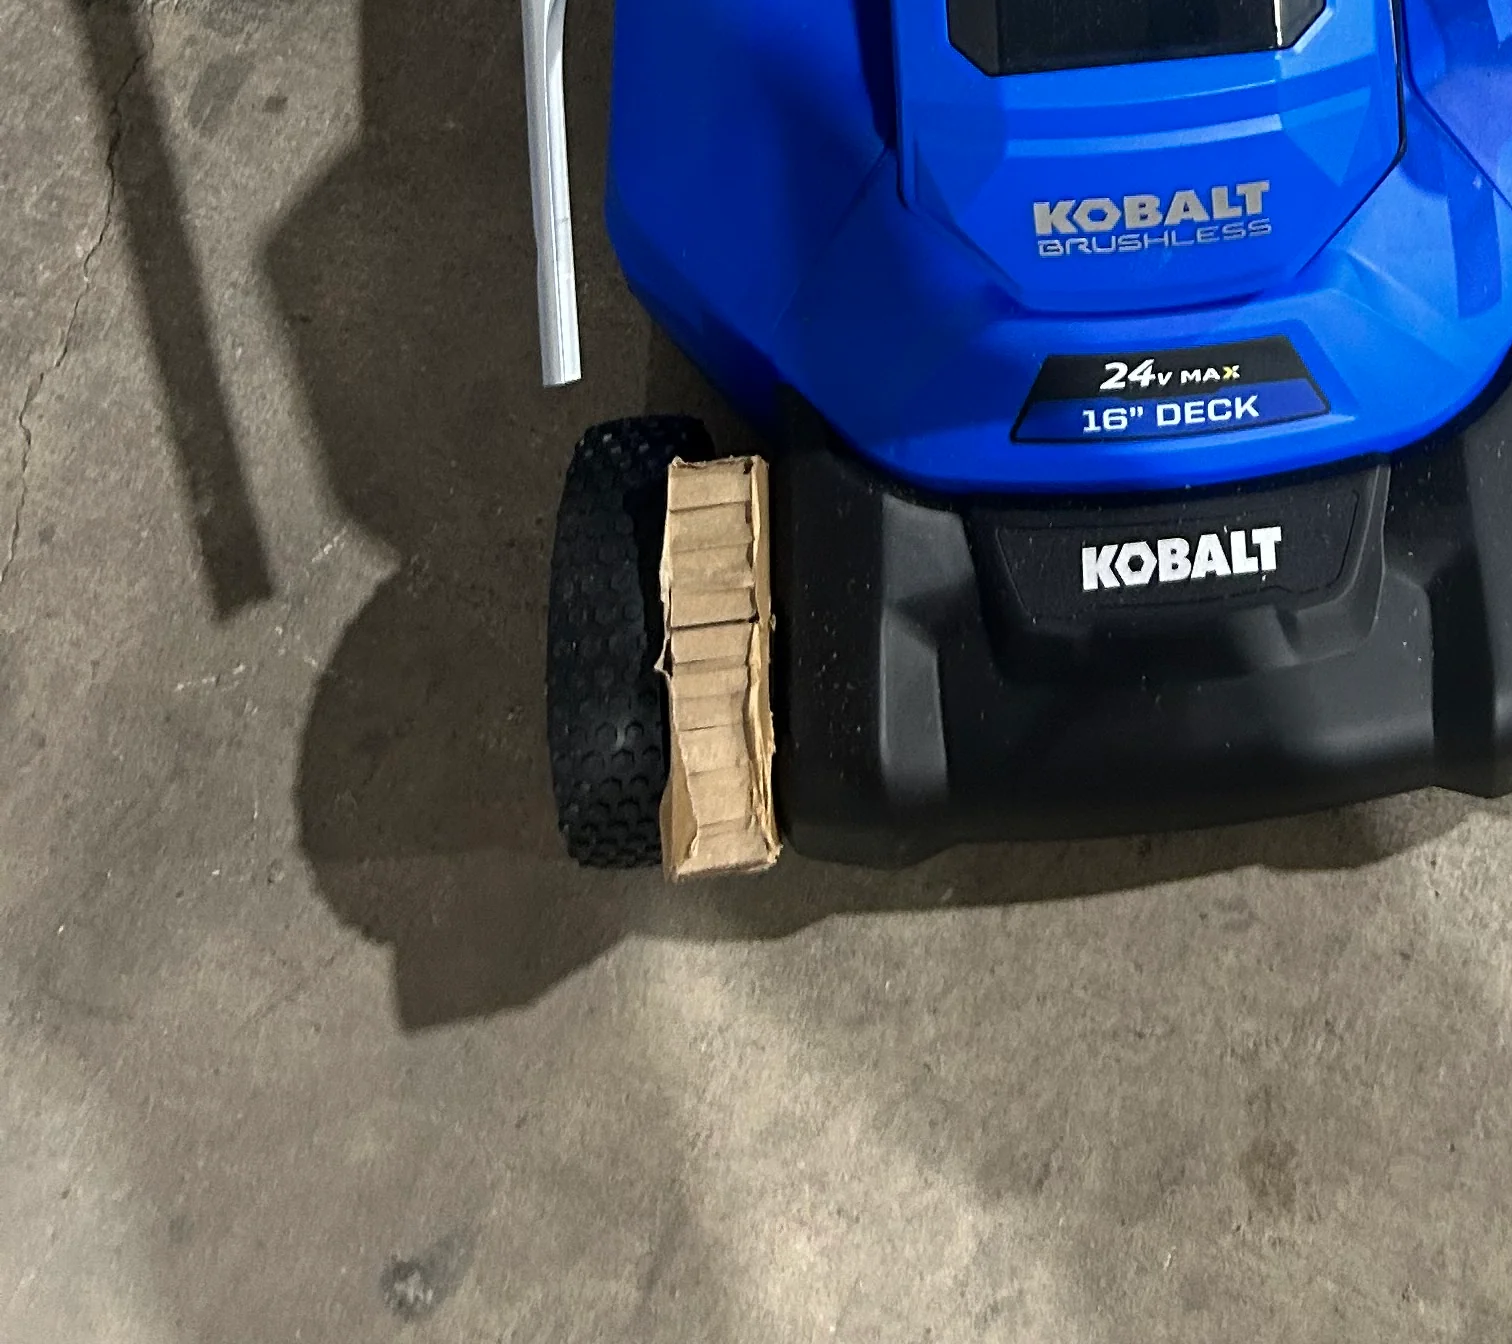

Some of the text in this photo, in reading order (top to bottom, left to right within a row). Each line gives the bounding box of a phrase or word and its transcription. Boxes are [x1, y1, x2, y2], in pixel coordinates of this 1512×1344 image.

[1033, 180, 1270, 235] KOBALT
[1038, 218, 1272, 258] BRUSHLESS
[1180, 363, 1241, 384] MAX
[1082, 395, 1259, 434] 16" DECK
[1082, 525, 1282, 590] KOBALT
